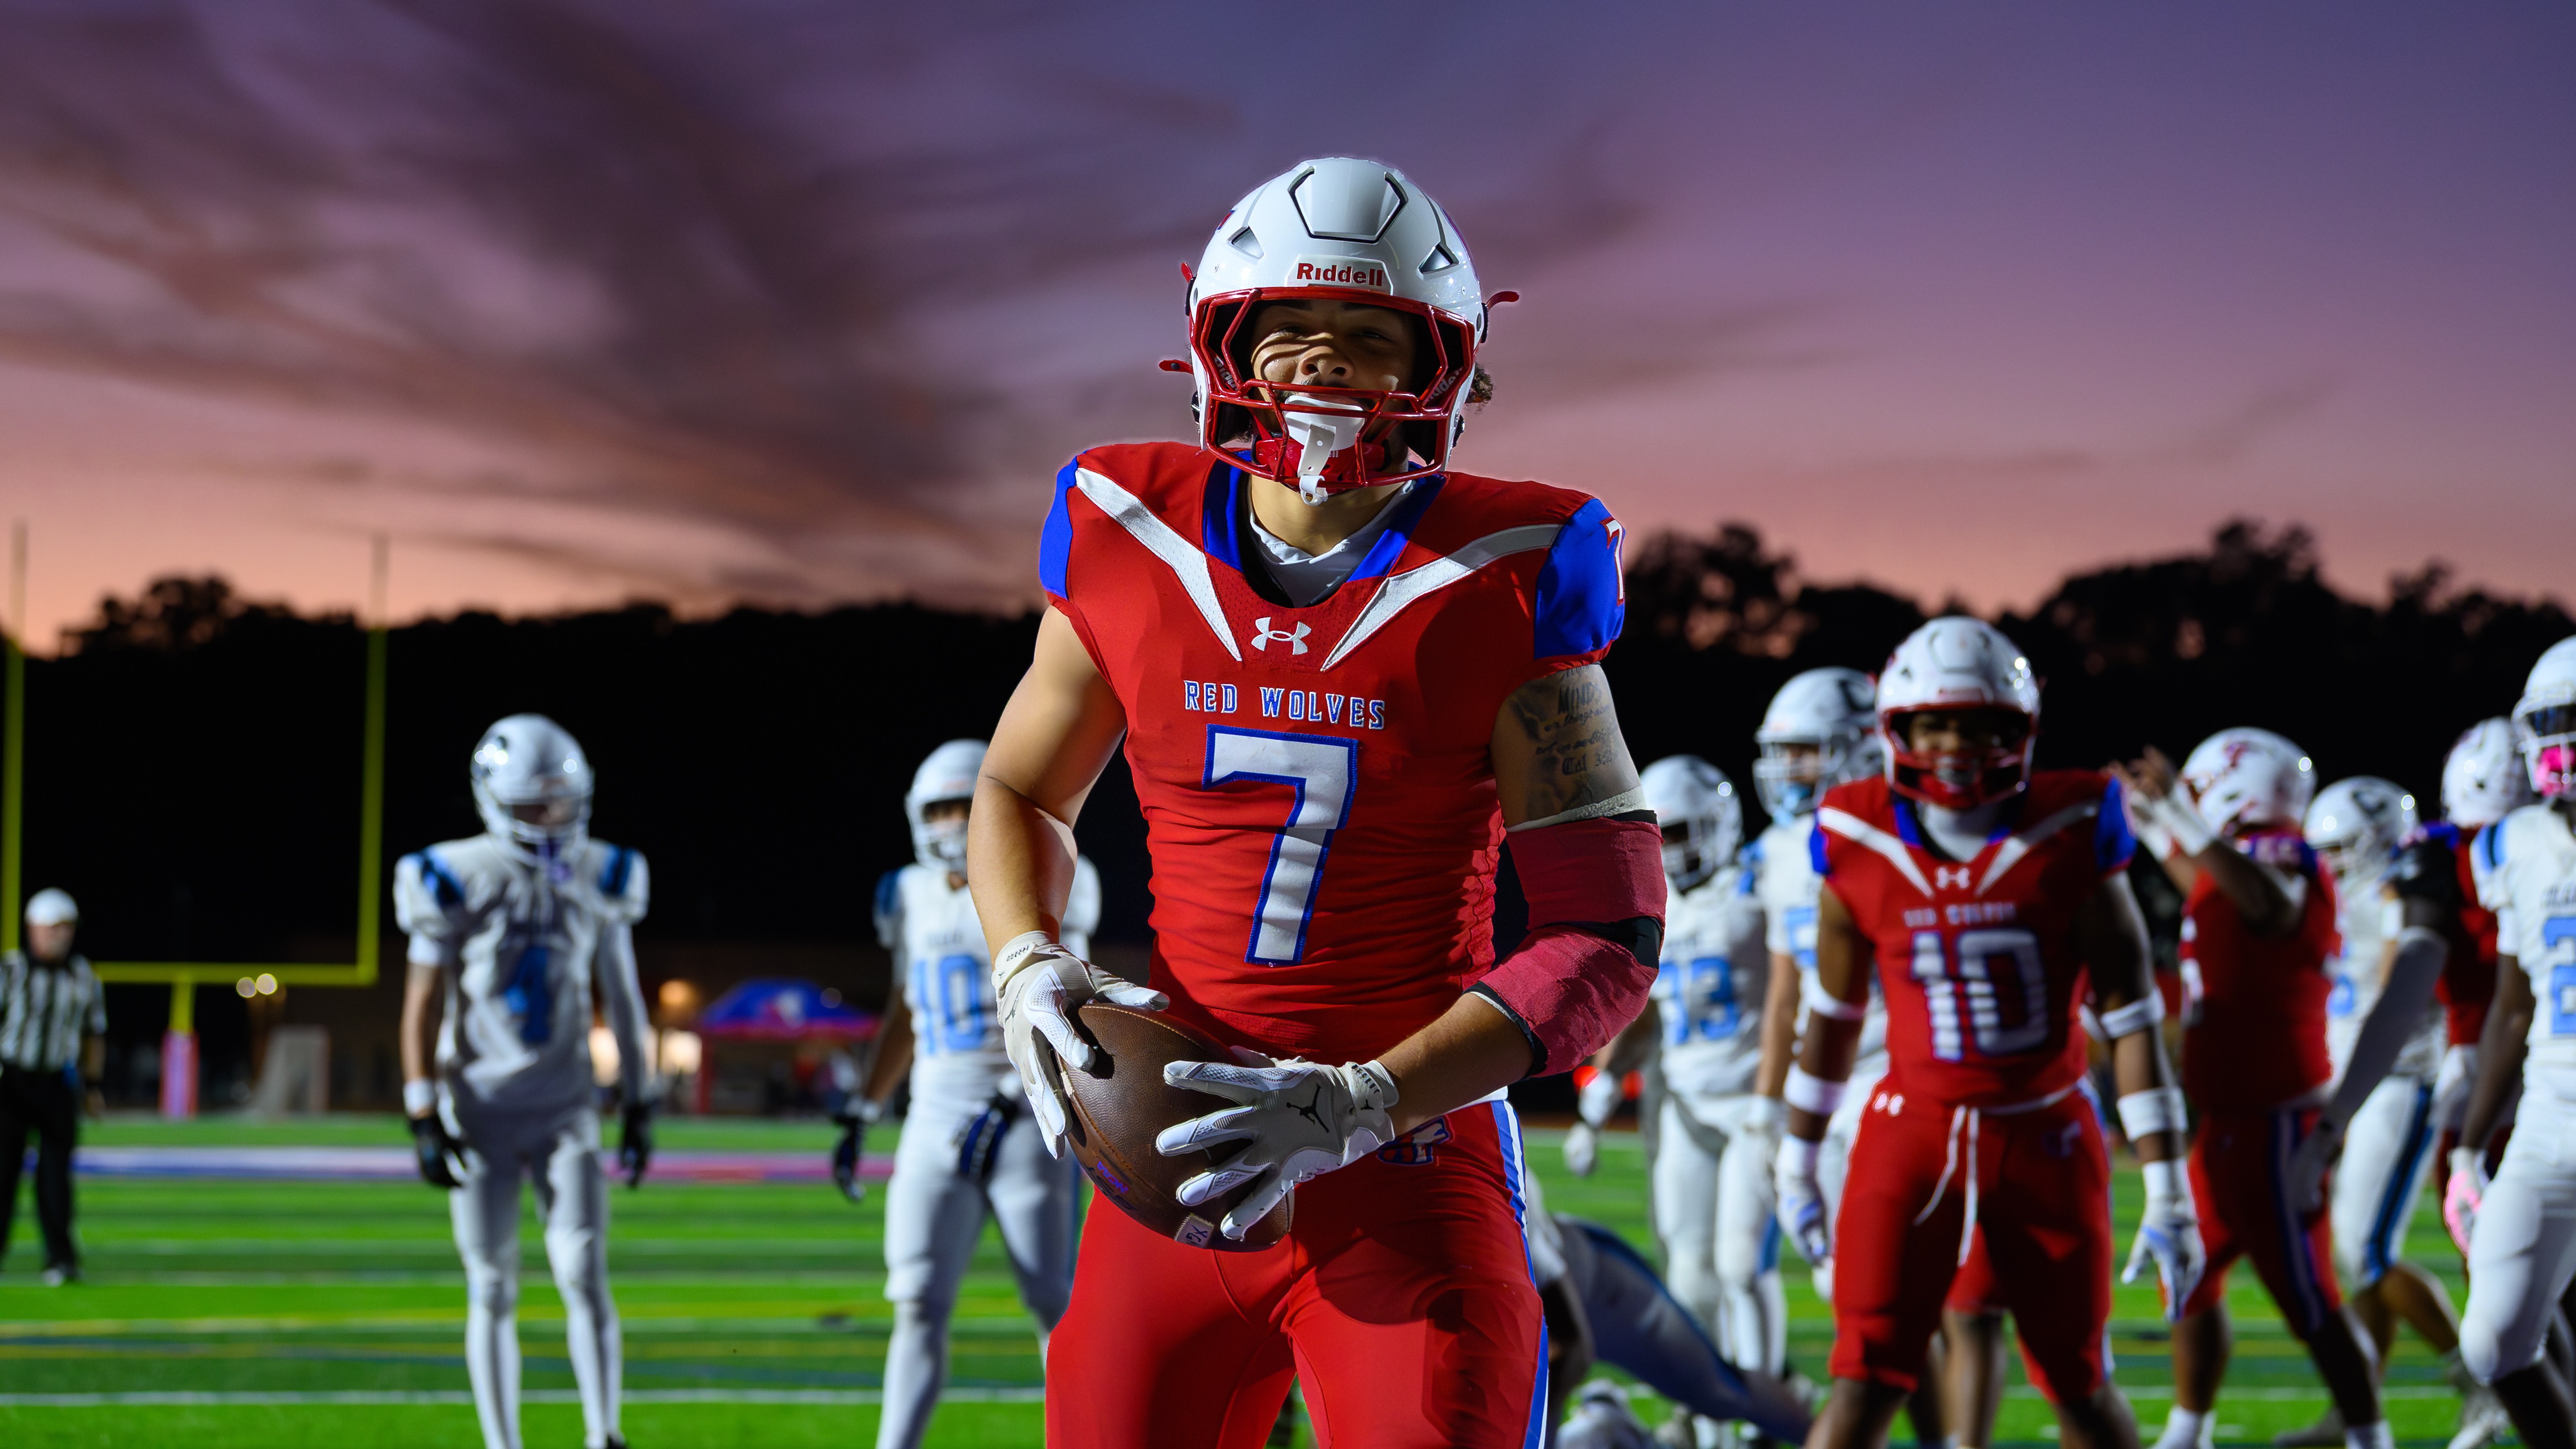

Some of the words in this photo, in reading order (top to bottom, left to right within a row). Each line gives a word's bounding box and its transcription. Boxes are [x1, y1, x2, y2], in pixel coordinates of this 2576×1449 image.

[1297, 263, 1383, 287] Riddell
[1600, 517, 1624, 606] 7
[1183, 680, 1238, 713] RED
[1259, 687, 1385, 730] WOLVES
[1202, 723, 1359, 965] 7
[912, 955, 986, 1055] 10
[1909, 928, 2047, 1061] 10
[1097, 1161, 1129, 1194] NCAA
